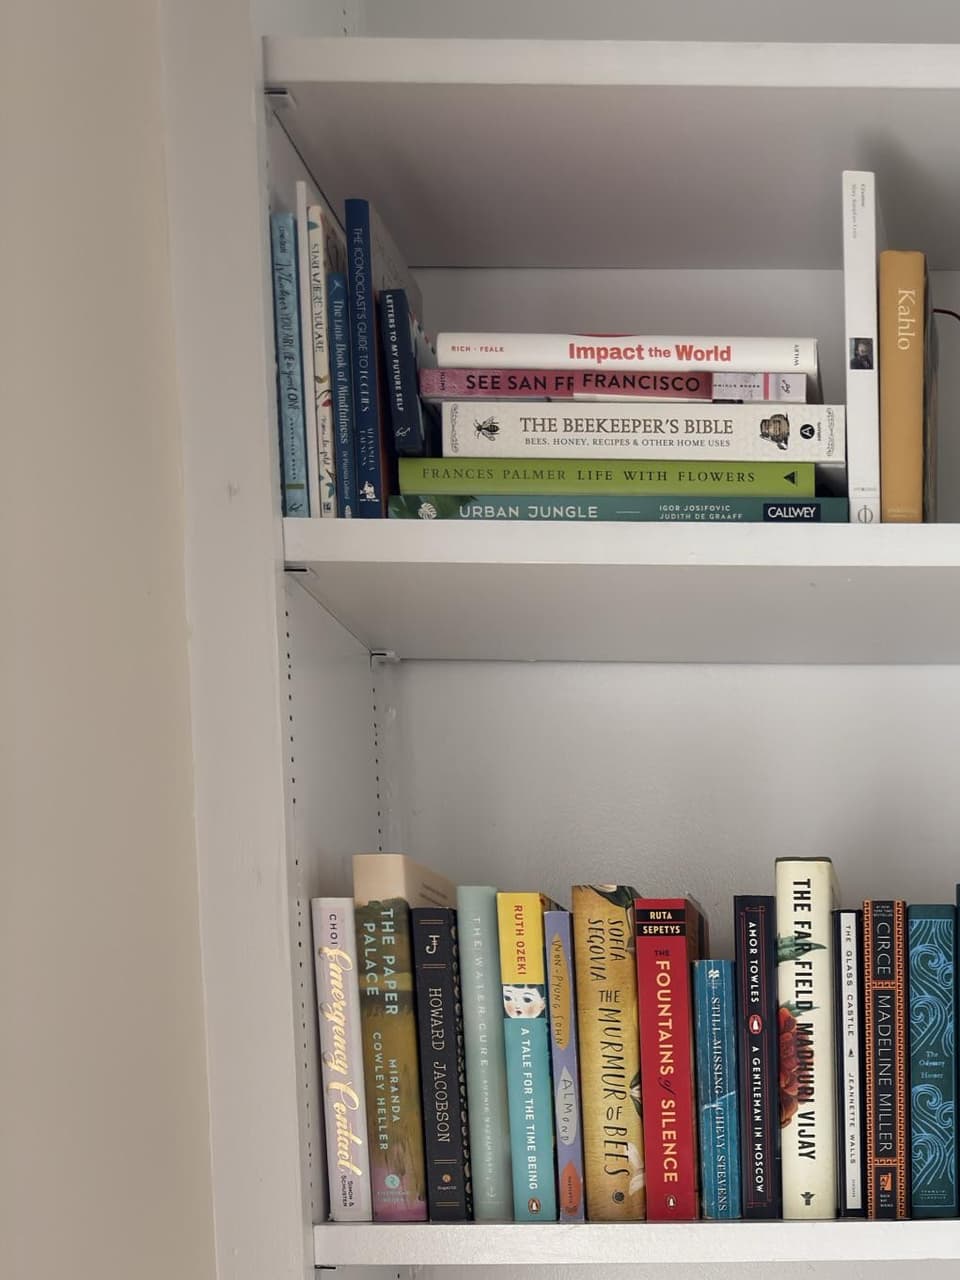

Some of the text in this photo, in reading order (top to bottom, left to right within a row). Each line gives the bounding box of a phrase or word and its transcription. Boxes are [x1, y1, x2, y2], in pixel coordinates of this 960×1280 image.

[897, 289, 916, 350] Kahlo
[386, 295, 404, 411] LETTERS TO MY FUTURE SELF
[569, 343, 732, 364] Impact the World
[582, 373, 700, 392] FRANCISCO
[520, 418, 733, 435] THE BEEKEEPER'S BIBLE
[422, 468, 566, 481] FRANCES PALMER
[577, 470, 755, 483] LIFE WITH FLOWERS
[459, 505, 597, 519] URBAN JUNGLE
[767, 506, 815, 518] CALLWEY
[329, 913, 338, 945] CHOI
[514, 904, 525, 975] RUTH OZEKI
[642, 926, 680, 935] SEPETYS
[649, 911, 672, 920] RUTA
[794, 879, 813, 1010] THE FAR FIELD
[364, 923, 378, 996] PALACE
[381, 908, 398, 1015] THE PAPER
[587, 918, 603, 981] SEGOVIA
[749, 922, 760, 1003] AMOR TOWLES
[876, 922, 891, 974] CIRCE
[372, 1032, 388, 1151] COWLEY HELLER
[388, 1059, 400, 1122] MIRANDA
[429, 987, 449, 1142] HOWARD JACOBSON
[752, 1058, 762, 1121] GENTLEMAN
[877, 995, 892, 1153] MADELINE MILLER
[520, 1028, 538, 1189] A TALE FOR THE TIME BEING
[754, 1128, 762, 1139] IN
[754, 1144, 764, 1193] MOSCOW
